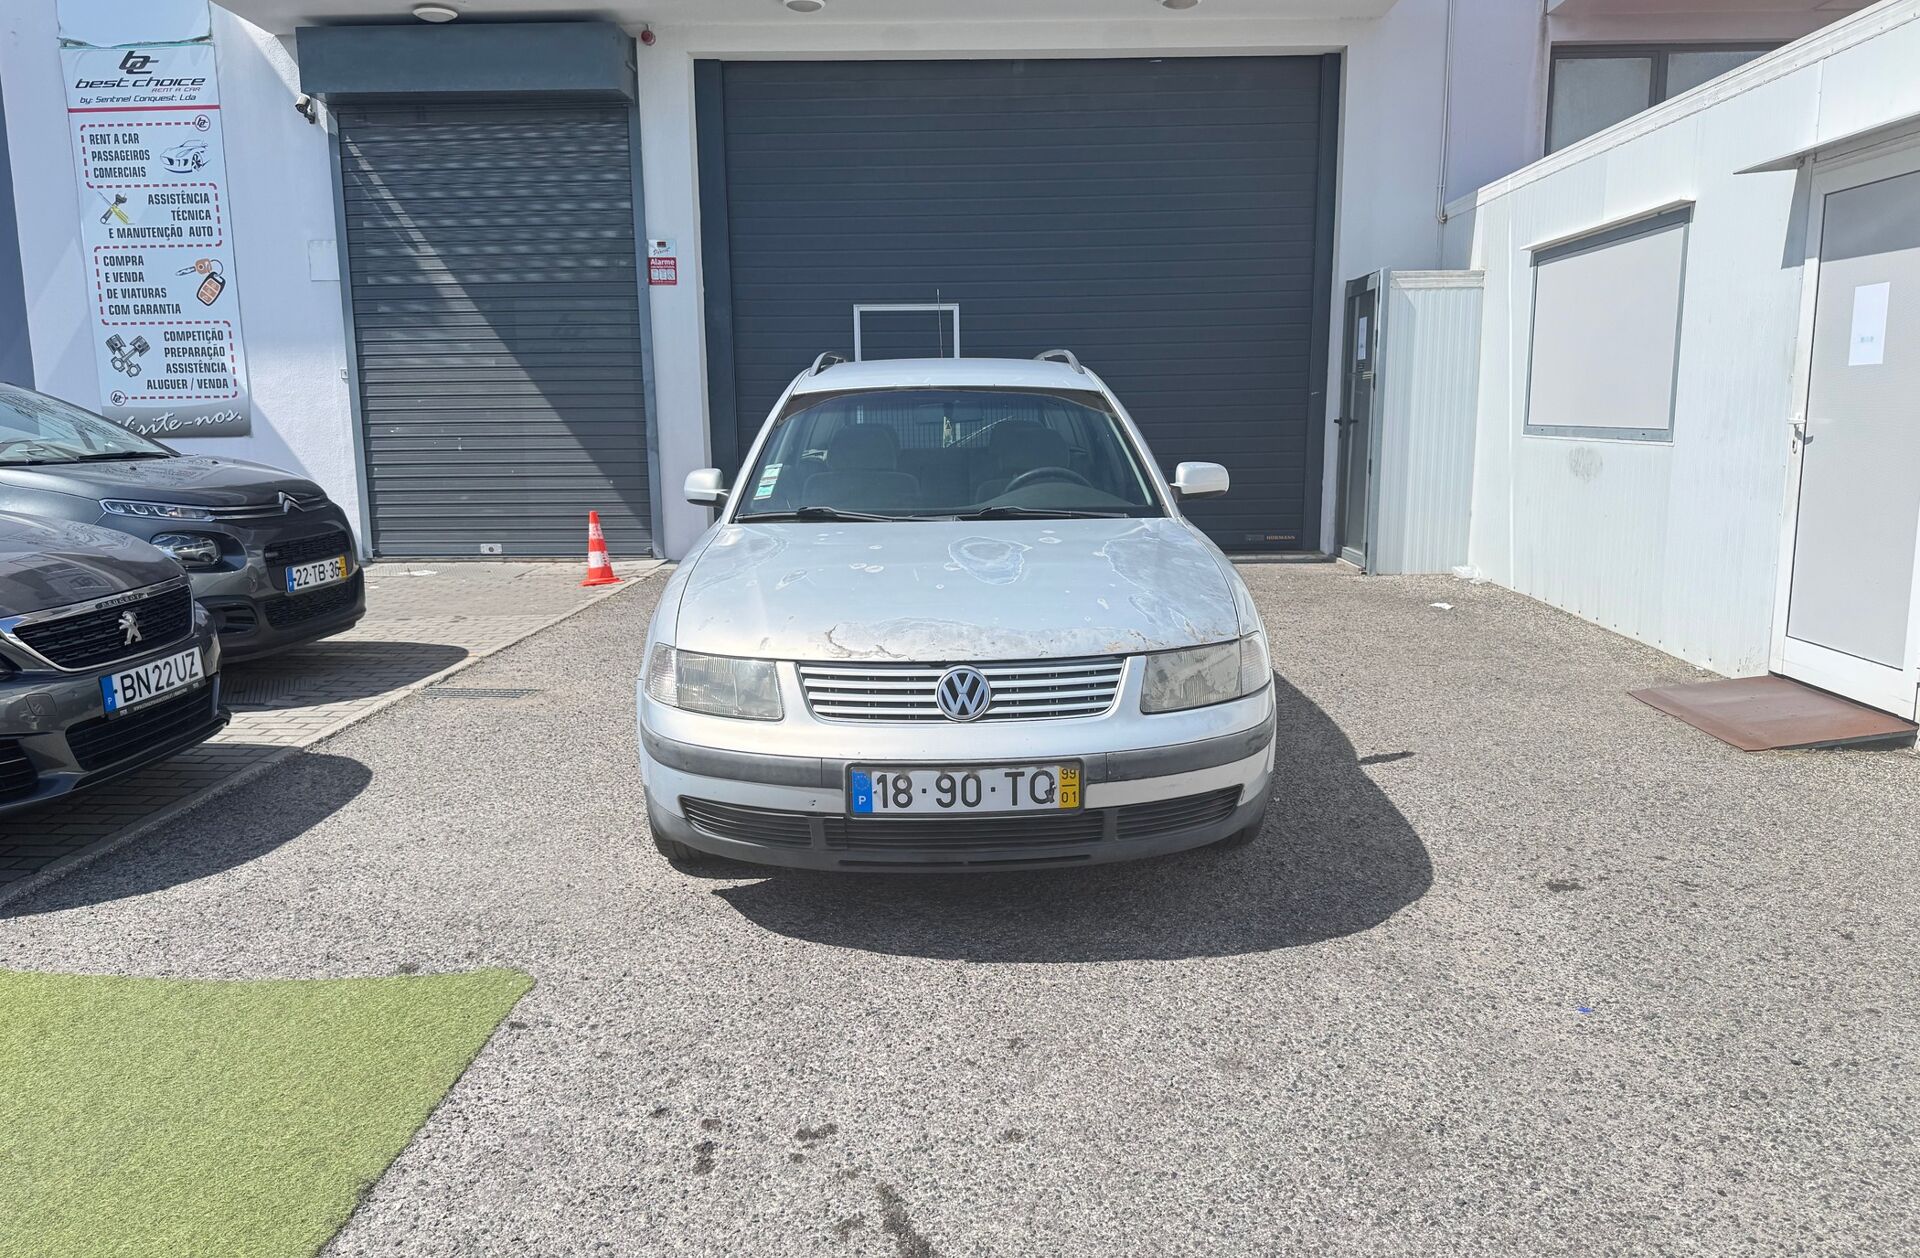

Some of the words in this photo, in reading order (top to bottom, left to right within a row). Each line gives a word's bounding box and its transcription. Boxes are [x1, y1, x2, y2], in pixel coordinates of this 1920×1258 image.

[75, 77, 130, 88] best
[132, 77, 206, 87] choice
[80, 96, 93, 104] by:
[89, 133, 111, 145] RENT
[114, 133, 120, 144] A
[122, 133, 139, 144] CAR
[92, 150, 150, 161] PASSAGEIROS
[94, 166, 146, 178] COMERCIAIS
[148, 190, 210, 205] ASSISTÊNCIA
[171, 207, 211, 221] TÉCNICA
[109, 228, 114, 239] E
[116, 225, 183, 240] MANUTENÇÃO
[189, 226, 213, 237] AUTO
[103, 256, 144, 266] COMPRA
[650, 258, 675, 266] Alarme
[105, 272, 110, 283] E
[112, 272, 144, 282] VENDA
[107, 288, 118, 299] DE
[120, 288, 167, 298] VIATURAS
[109, 305, 130, 315] COM
[134, 304, 181, 315] GARANTIA
[164, 328, 224, 344] COMPETIÇÃO
[164, 344, 226, 360] PREPARAÇÃO
[166, 360, 227, 373] ASSISTÊNCIA
[147, 379, 188, 390] ALUGUER
[197, 378, 228, 389] VENDA
[1061, 769, 1076, 780] 99
[858, 796, 867, 805] P
[1061, 792, 1076, 803] 01
